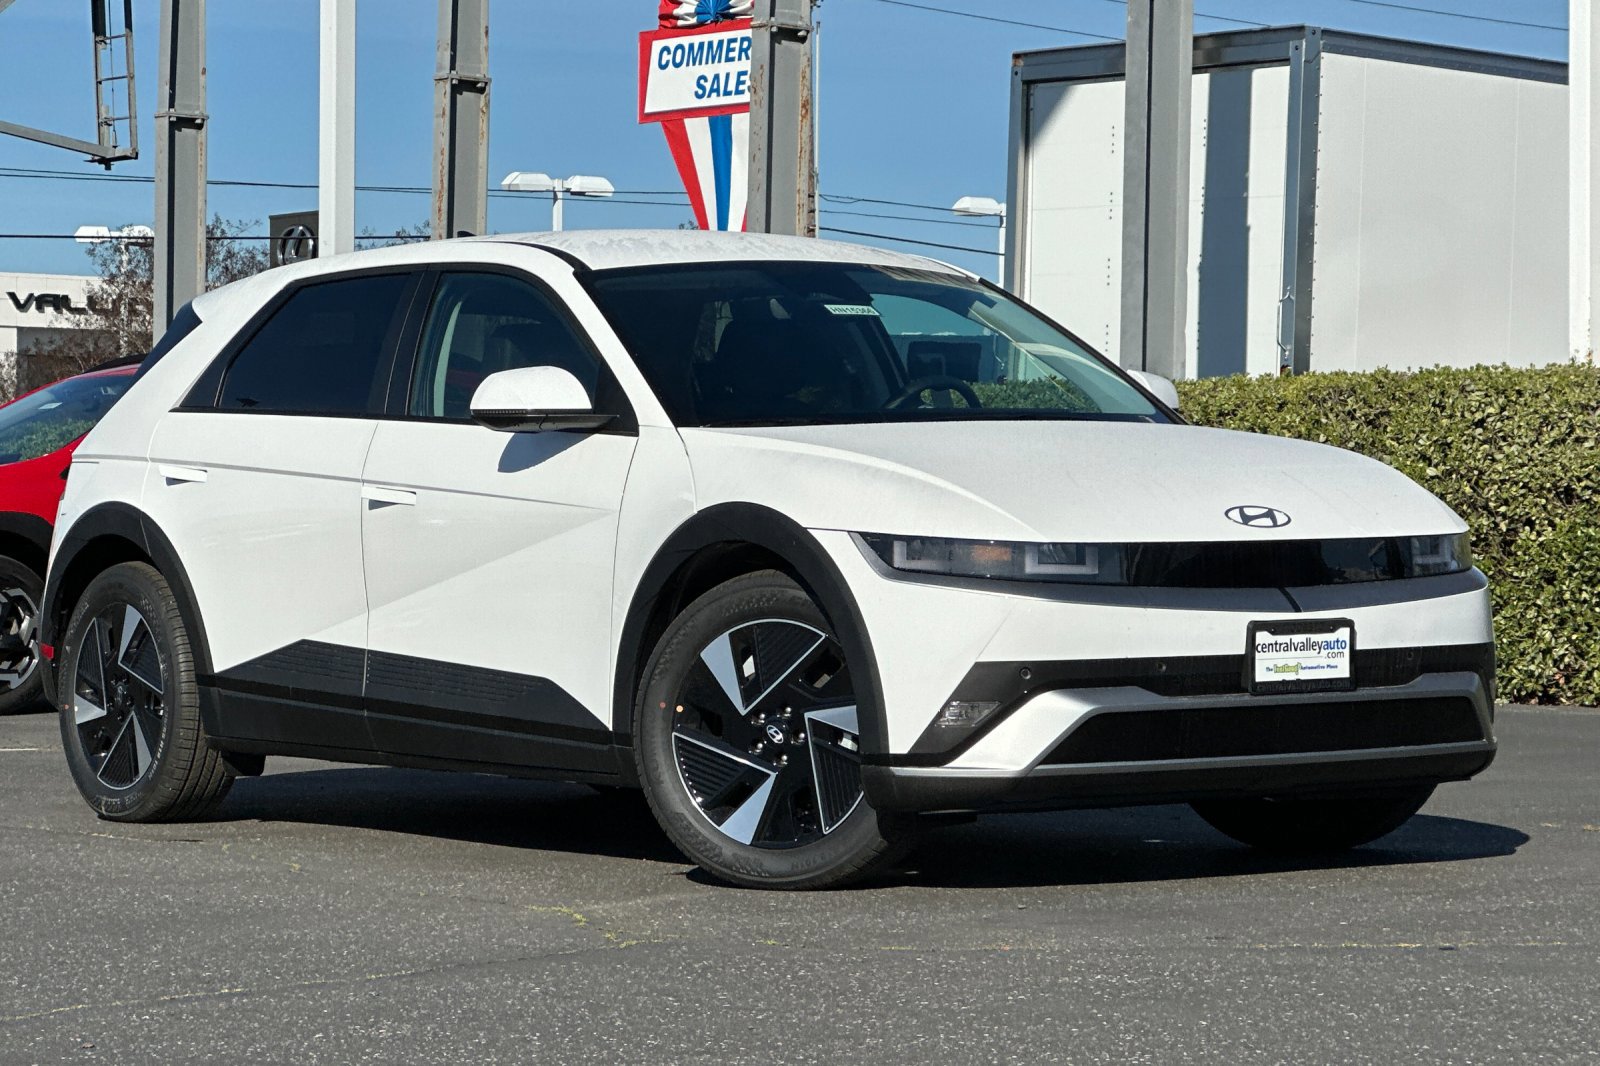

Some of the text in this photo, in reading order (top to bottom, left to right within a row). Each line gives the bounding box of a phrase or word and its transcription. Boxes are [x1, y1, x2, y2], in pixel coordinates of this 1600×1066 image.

[694, 70, 751, 100] SALE
[1255, 637, 1347, 655] centralvalleyauto
[1324, 651, 1345, 660] .com
